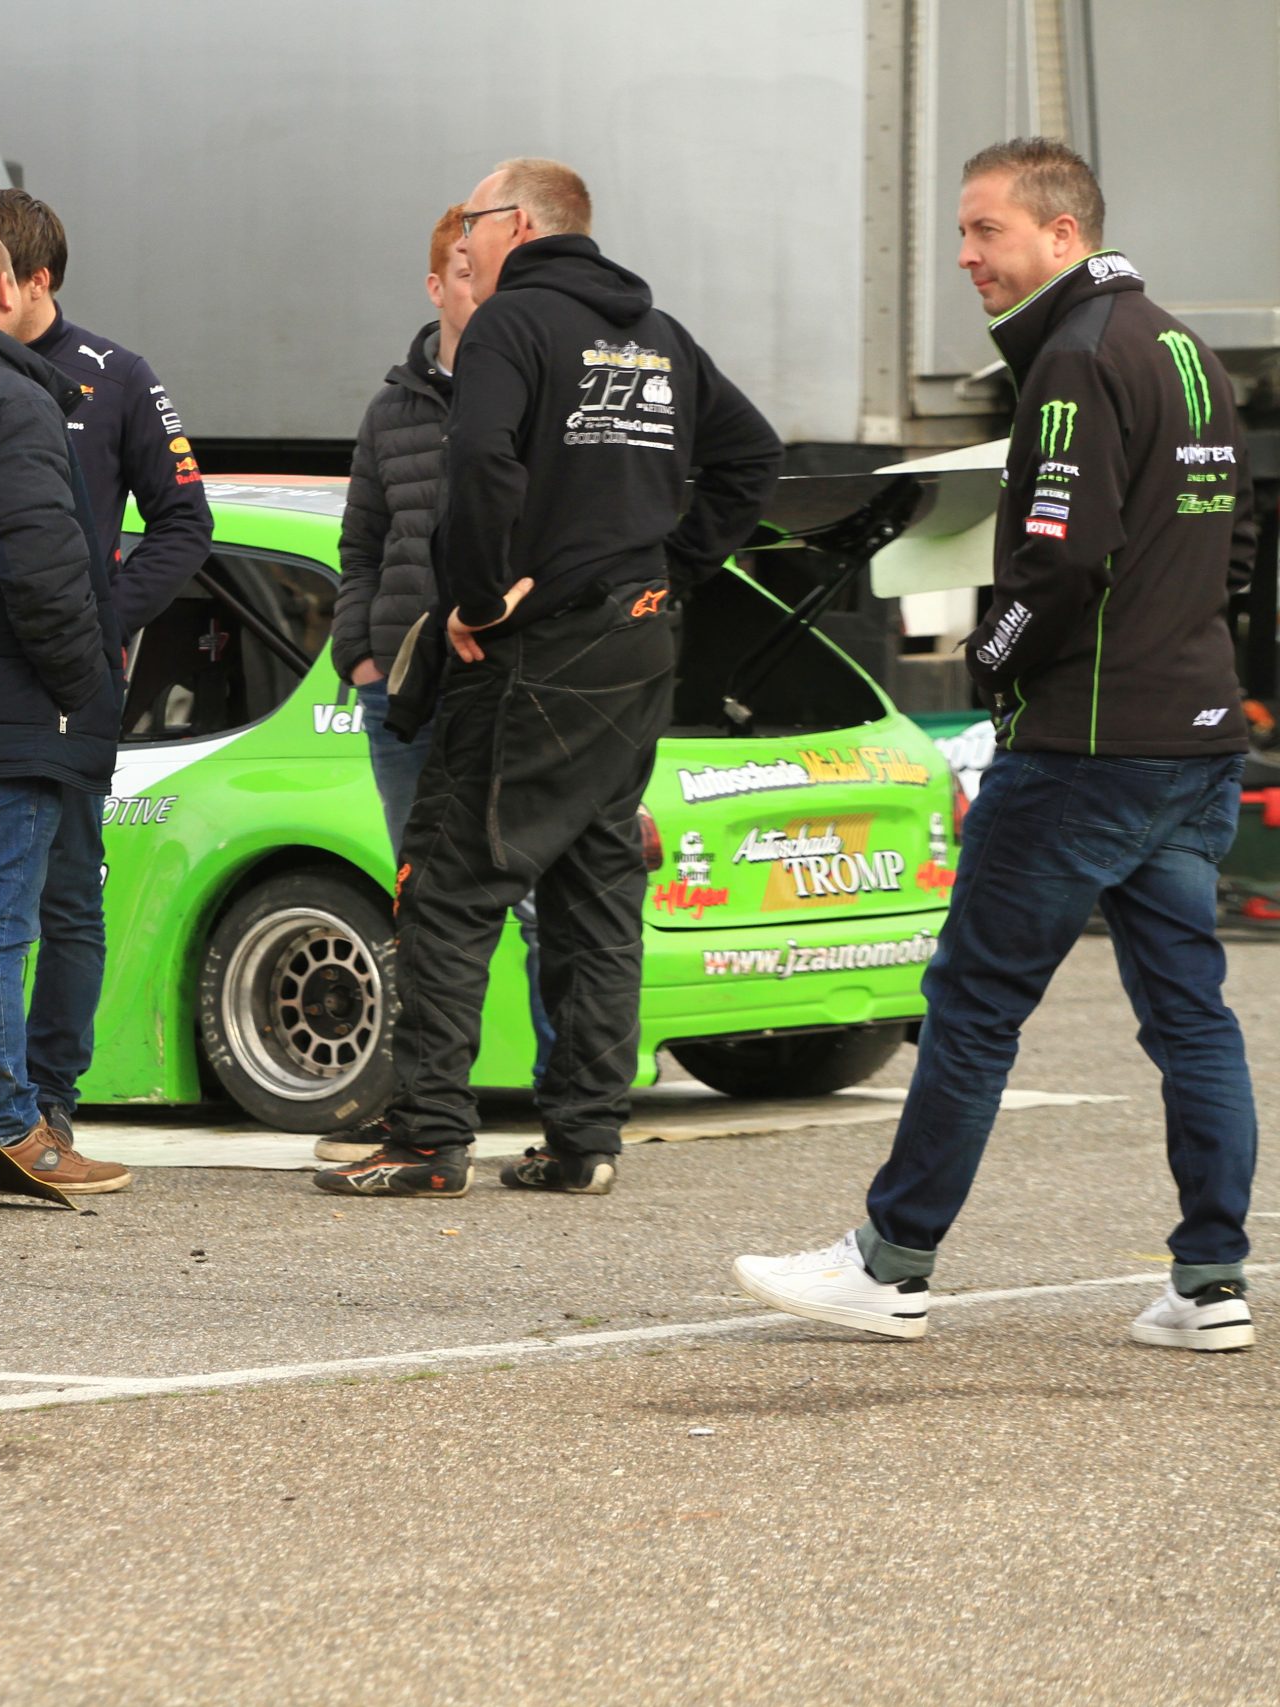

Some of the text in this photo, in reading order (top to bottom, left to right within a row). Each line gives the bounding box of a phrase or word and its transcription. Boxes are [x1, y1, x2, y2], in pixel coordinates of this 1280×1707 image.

[1039, 461, 1081, 477] STER
[1175, 444, 1237, 465] MNSTER
[1186, 472, 1228, 482] ENEGY
[982, 601, 1028, 659] YAMAHA
[313, 704, 366, 734] Vel
[102, 795, 179, 826] OTIVE
[783, 850, 905, 898] TROMP
